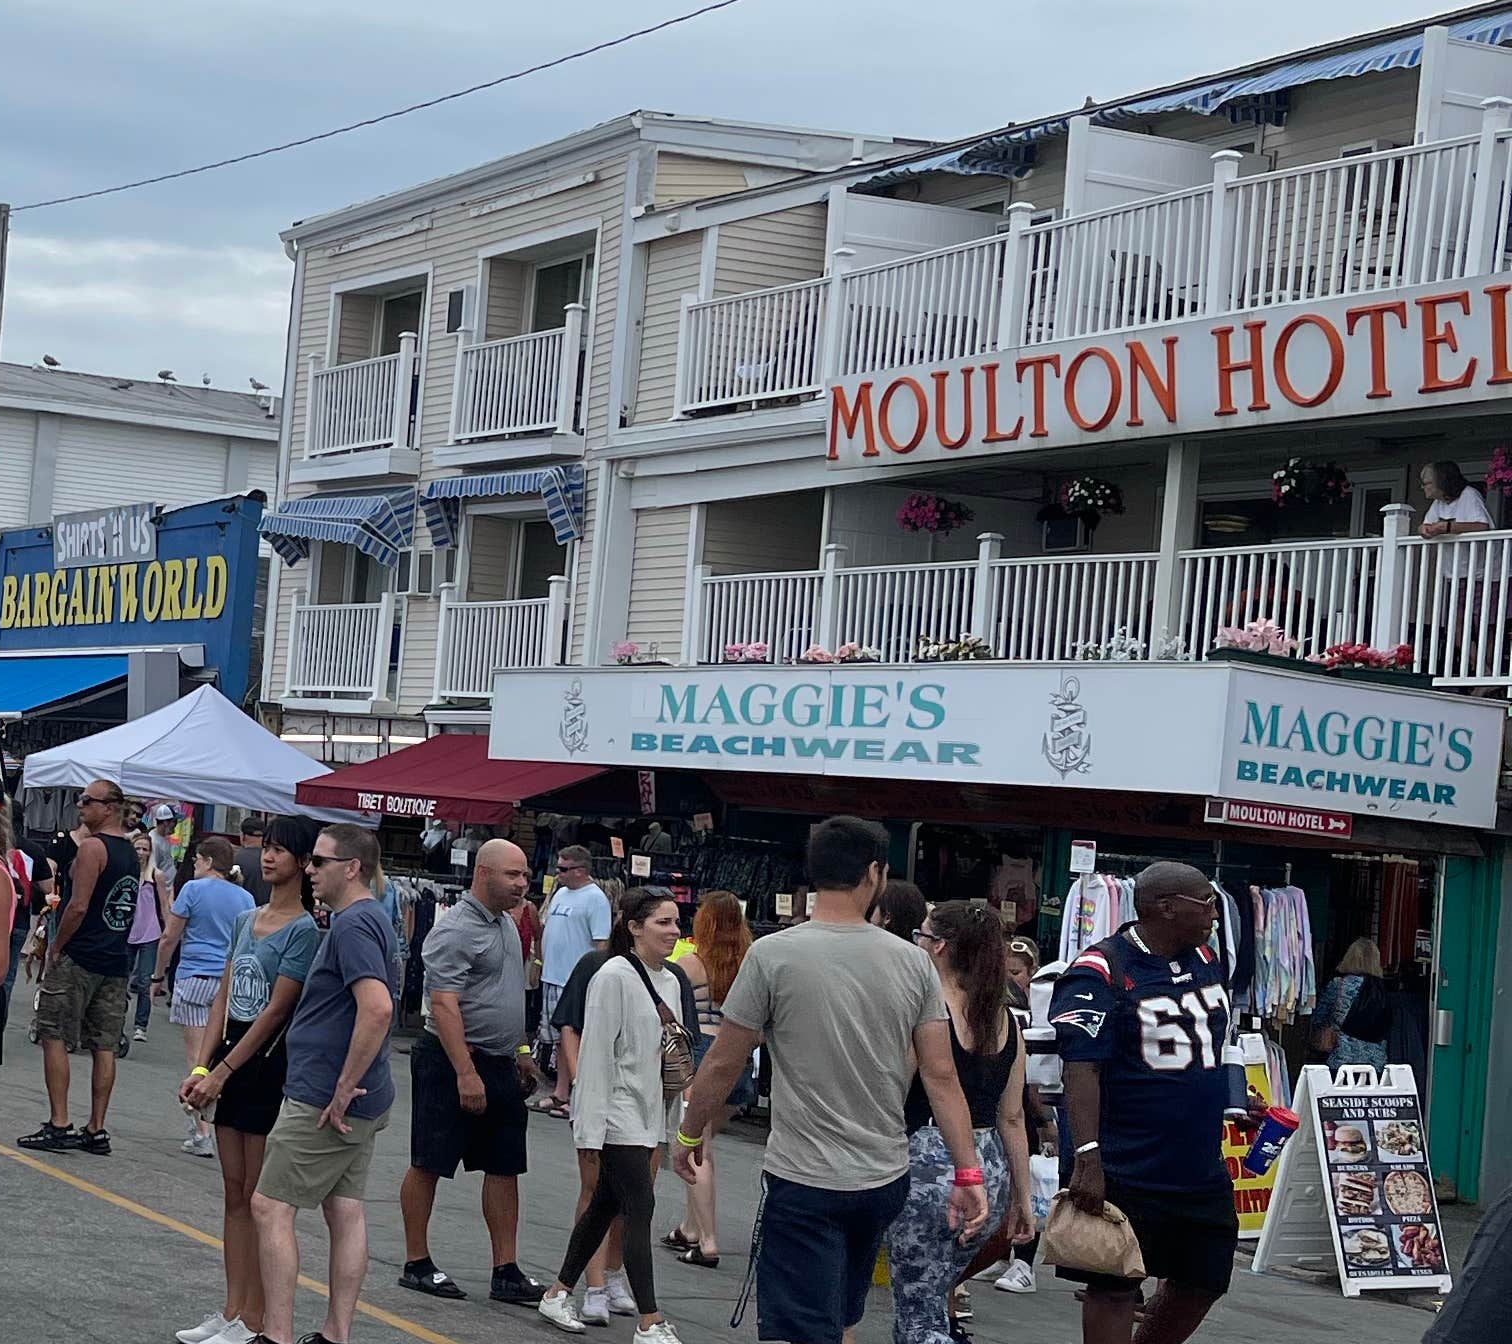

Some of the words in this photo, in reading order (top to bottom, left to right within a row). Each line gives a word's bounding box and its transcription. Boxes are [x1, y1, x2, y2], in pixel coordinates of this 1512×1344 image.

[826, 335, 1180, 461] MOULTON
[57, 516, 107, 562] SHIRTS
[129, 511, 151, 554] US
[0, 565, 118, 629] BARGAIN
[119, 555, 228, 623] WORLD
[655, 679, 946, 731] MAGGIE'S
[630, 731, 983, 767] BEACHWEAR
[1240, 700, 1474, 773] MAGGIE'S
[357, 792, 385, 810] TIBET
[386, 795, 438, 817] BOUTIQUE
[1237, 759, 1458, 807] BEACHWEAR
[1229, 804, 1286, 824] MOULTON
[1287, 811, 1326, 831] HOTEL
[1136, 983, 1231, 1070] 617
[1321, 1098, 1369, 1108] SEASIDE
[1371, 1097, 1414, 1107] SCOOPS
[1342, 1108, 1366, 1118] AND
[1368, 1107, 1398, 1118] SUBS
